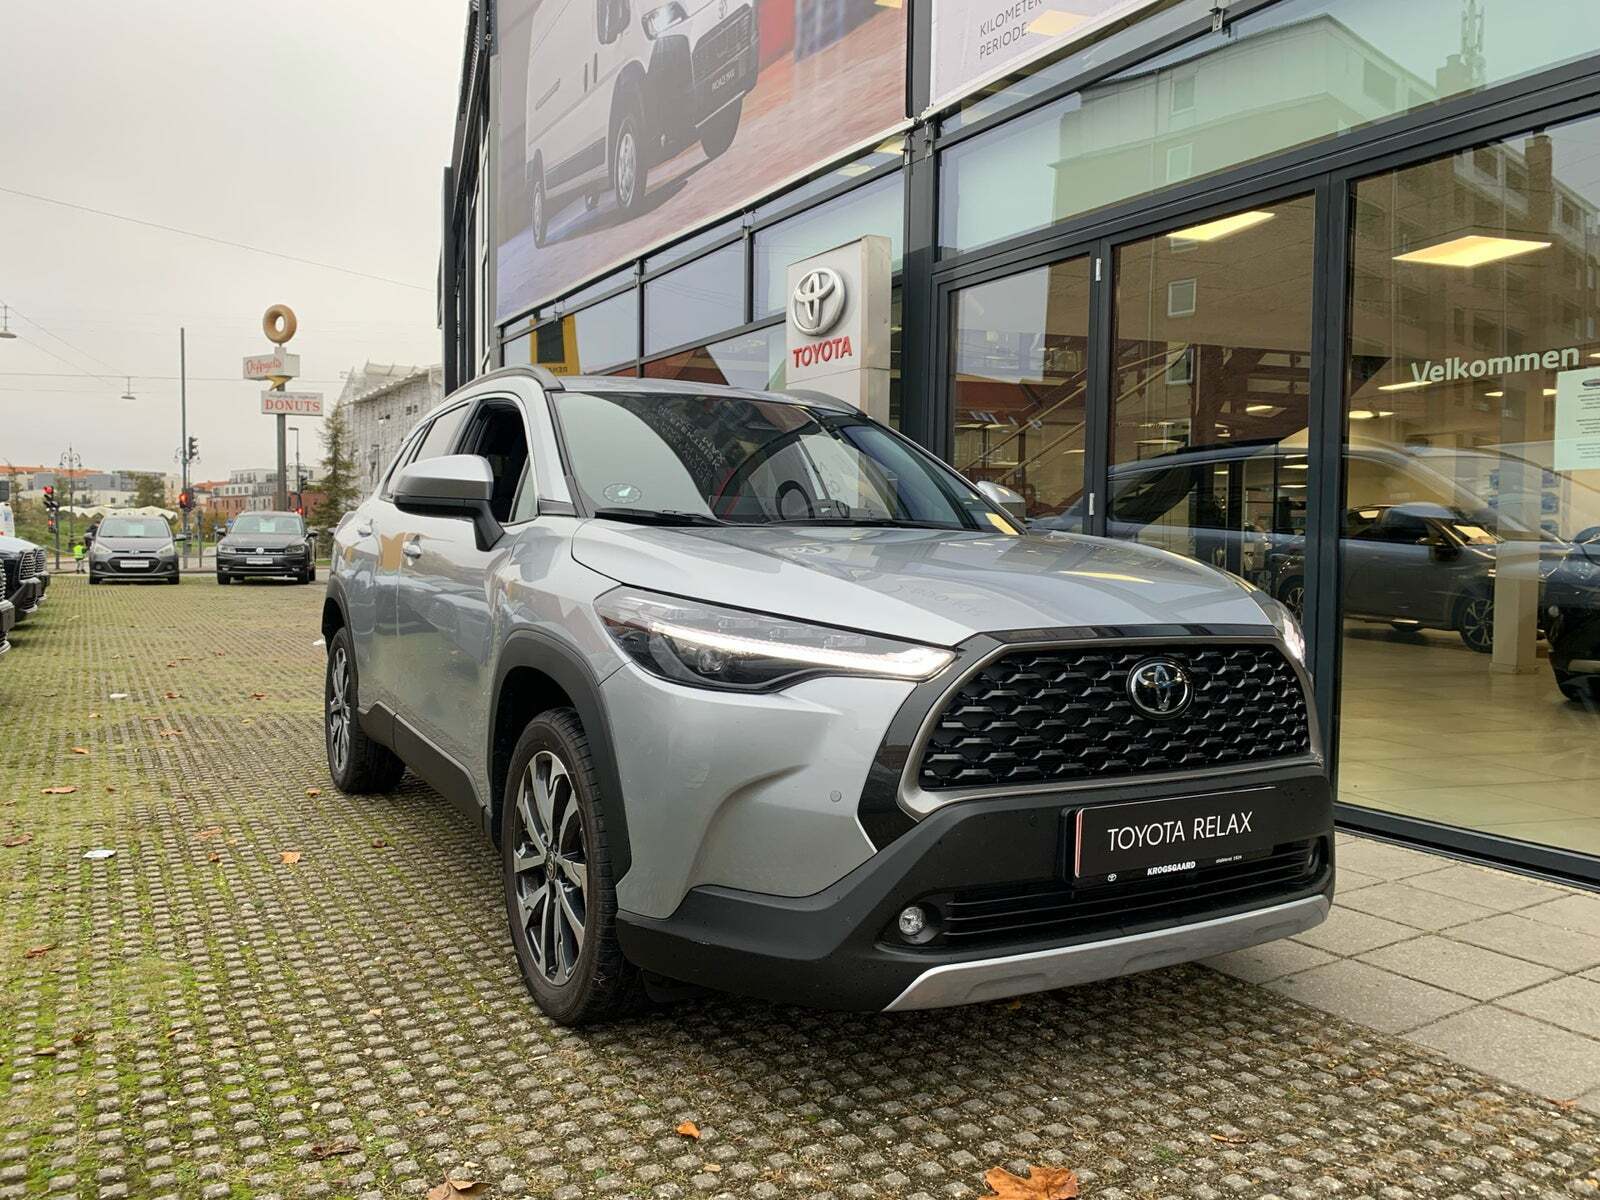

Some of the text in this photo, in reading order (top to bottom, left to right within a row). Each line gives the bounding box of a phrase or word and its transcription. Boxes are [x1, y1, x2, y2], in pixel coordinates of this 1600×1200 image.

[793, 336, 852, 368] TOYOTA
[1411, 347, 1580, 383] Velkommen
[265, 399, 320, 412] DONUTS
[1107, 811, 1253, 851] TOYOTA RELAX
[1147, 861, 1196, 876] KROGSGAARD
